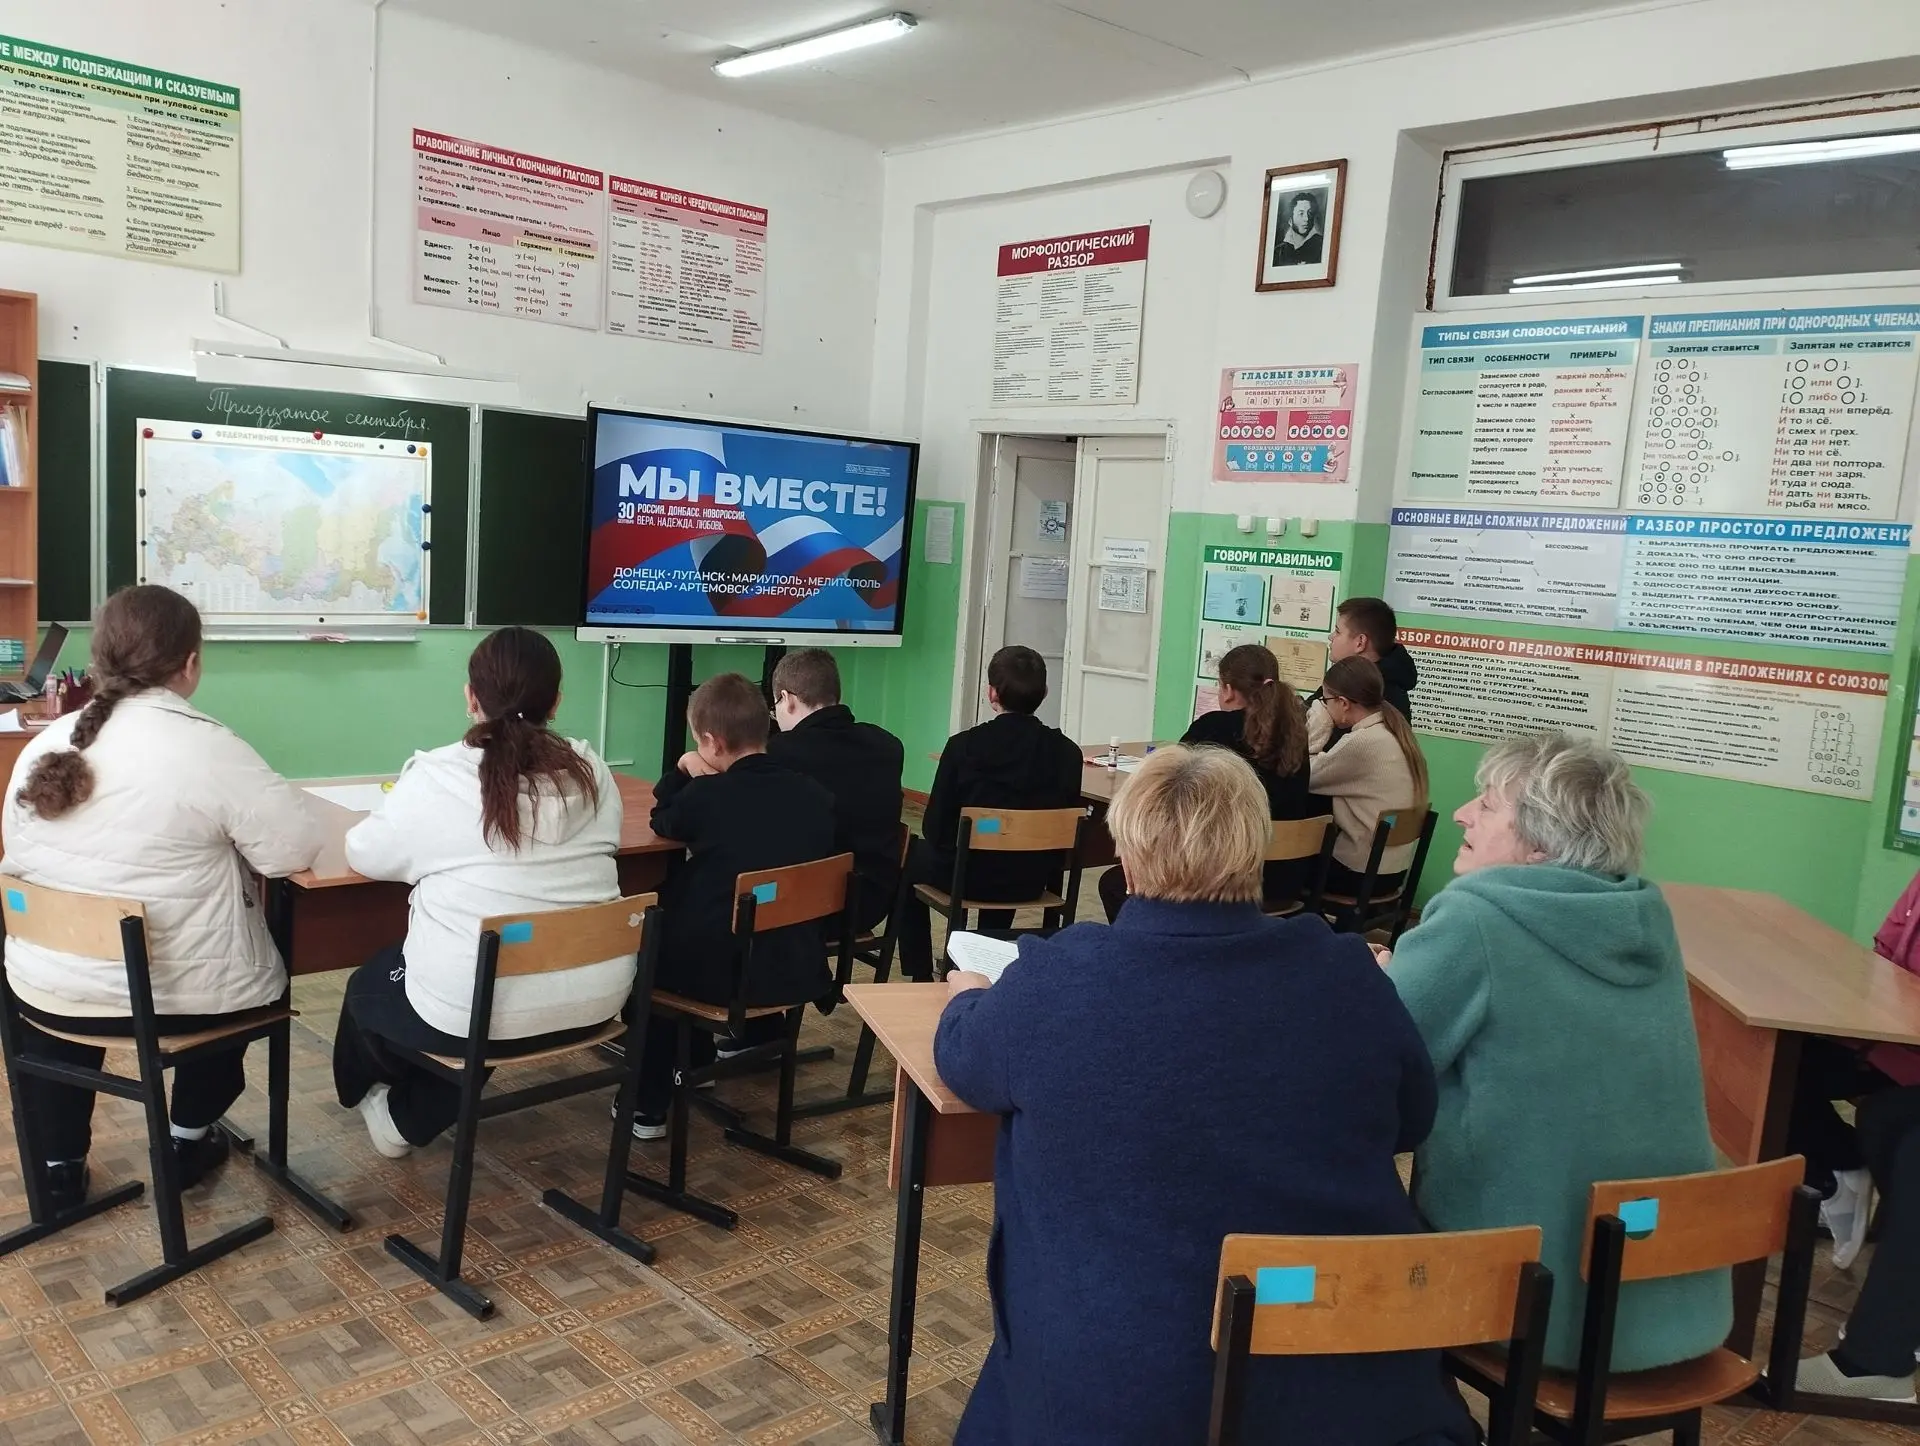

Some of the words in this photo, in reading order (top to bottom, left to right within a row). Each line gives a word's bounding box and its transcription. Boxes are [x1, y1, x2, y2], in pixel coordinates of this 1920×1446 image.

[13, 46, 59, 66] МЕЖДУ
[62, 57, 151, 85] ПОДЛЕЖАЩИМ
[154, 77, 162, 89] И
[166, 80, 234, 103] СКАЗУЕМЫМ
[13, 80, 36, 88] тире
[39, 85, 84, 98] ставится:
[18, 69, 79, 85] подлежащим
[90, 84, 141, 98] сказуемым
[162, 100, 197, 110] нулевой
[199, 108, 227, 117] связке
[143, 107, 164, 115] тире
[180, 115, 220, 127] ставится:
[415, 135, 479, 157] ПРАВОПИСАНИЕ
[481, 150, 514, 165] ЛИЧНЫХ
[516, 158, 561, 176] ОКОНЧАНИЙ
[562, 169, 599, 185] ГЛАГОЛОВ
[612, 181, 657, 198] ПРАВОПИСАНИЕ
[660, 191, 682, 203] КОРНЕЙ
[682, 196, 687, 205] С
[432, 217, 455, 227] Число
[482, 229, 501, 238] Лицо
[520, 242, 552, 251] спряжение
[523, 230, 551, 240] Личные
[553, 237, 590, 247] окончания
[1012, 232, 1135, 260] МОРФОЛОГИЧЕСКИЙ
[1048, 253, 1094, 269] РАЗБОР
[1438, 332, 1469, 340] ТИПЫ
[1472, 329, 1509, 339] СВЯЗИ
[1512, 323, 1626, 337] СЛОВОСОЧЕТАНИЙ
[1652, 321, 1686, 333] ЗНАКИ
[1688, 318, 1760, 331] ПРЕПИНАНИЯ
[1762, 317, 1786, 329] ПРИ
[1789, 314, 1870, 329] ОДНОРОДНЫХ
[1874, 313, 1920, 325] ЧЛЕНАХ
[1484, 353, 1550, 362] ОСОБЕННОСТИ
[1570, 351, 1617, 359] ПРИМЕРЫ
[1242, 371, 1293, 380] ГЛАСНЫЕ
[1298, 370, 1333, 378] ЗВУКИ
[206, 387, 331, 428] Тридцатое
[346, 410, 430, 438] сентября.
[216, 430, 278, 441] ФЕДЕРАТИВНОЕ
[282, 436, 333, 447] УСТРОЙСТВО
[619, 463, 700, 502] МЫ
[715, 472, 888, 517] ВМЕСТЕ!
[618, 502, 634, 519] 30
[637, 503, 665, 517] РОССИЯ.
[667, 506, 700, 518] ДОНБАСС.
[702, 508, 746, 520] НОВОРОССИЯ.
[1785, 499, 1815, 508] рыба
[636, 515, 655, 525] ВЕРА.
[657, 517, 694, 528] НАДЕЖДА.
[695, 519, 724, 530] ЛЮБОВЬ.
[1398, 512, 1450, 523] ОСНОВНЫЕ
[1453, 514, 1482, 526] ВИДЫ
[1485, 515, 1539, 527] СЛОЖНЫХ
[1542, 517, 1627, 530] ПРЕДЛОЖЕНИЙ
[1636, 519, 1695, 532] РАЗБОР
[1699, 521, 1785, 535] ПРОСТОГО
[1214, 550, 1256, 562] ГОВОРИ
[1260, 553, 1332, 567] ПРАВИЛЬНО
[614, 567, 665, 580] ДОНЕЦК
[674, 570, 726, 581] ЛУГАНСК
[732, 573, 802, 585] МАРИУПОЛЬ
[808, 576, 880, 589] МЕЛИТОПОЛЬ
[613, 579, 672, 591] СОЛЕДАР
[679, 582, 749, 594] АРТЕМОВСК
[754, 585, 820, 597] ЭНЕРГОДАР
[1697, 596, 1792, 606] ГРАММАТИЧЕСКУЮ
[1638, 622, 1696, 631] ОБЪЯСНИТЬ
[1700, 627, 1765, 636] ПОСТАНОВКУ
[1813, 637, 1886, 647] ПРЕПИНАНИЯ.
[1395, 631, 1430, 642] АЗБОР
[1434, 635, 1504, 650] СЛОЖНОГО
[1508, 642, 1613, 660] ПРЕДЛОЖЕНИЯ
[1615, 653, 1694, 671] ПУНКТУАЦИЯ
[1694, 659, 1703, 674] В
[1705, 661, 1811, 681] ПРЕДЛОЖЕНИЯХ
[1816, 672, 1824, 684] С
[1828, 674, 1889, 690] СОЮЗОМ
